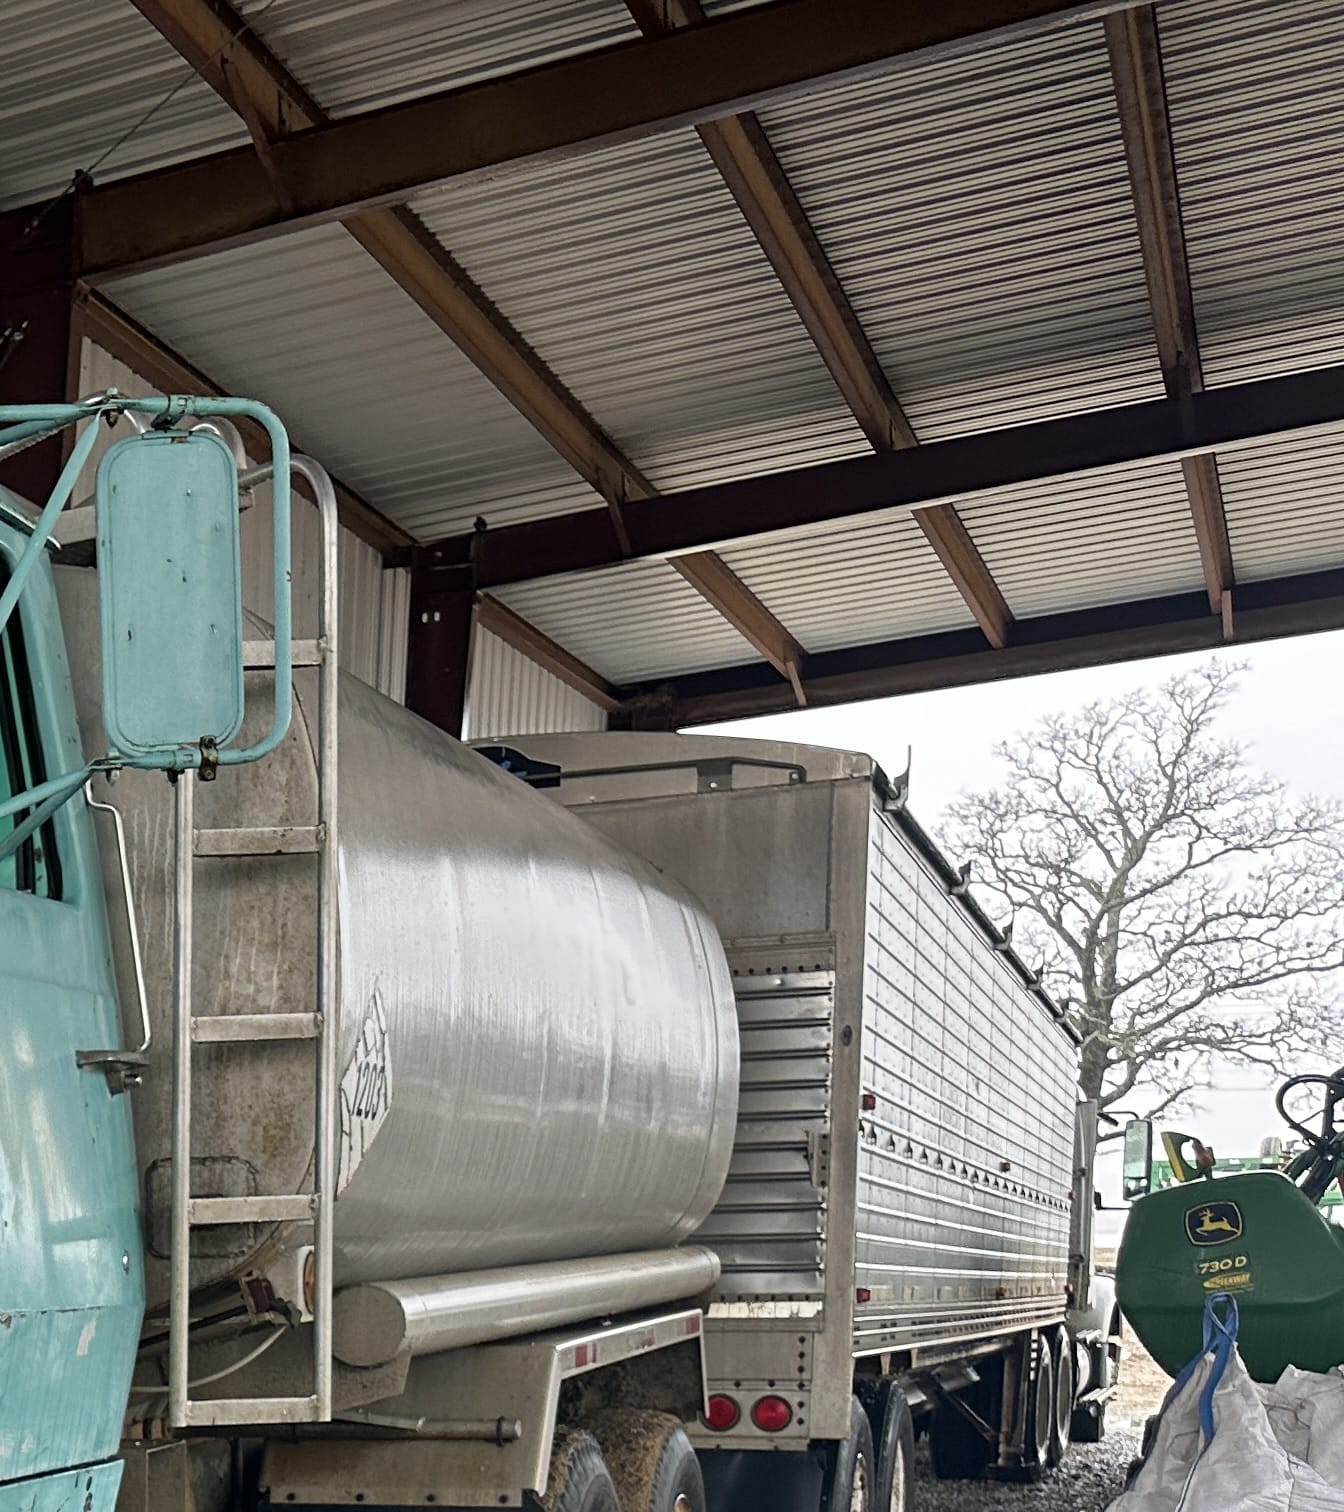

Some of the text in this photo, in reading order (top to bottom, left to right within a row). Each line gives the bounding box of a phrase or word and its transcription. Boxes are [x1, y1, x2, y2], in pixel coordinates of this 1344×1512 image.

[352, 1062, 385, 1120] 1203
[1199, 1256, 1247, 1274] 730 D
